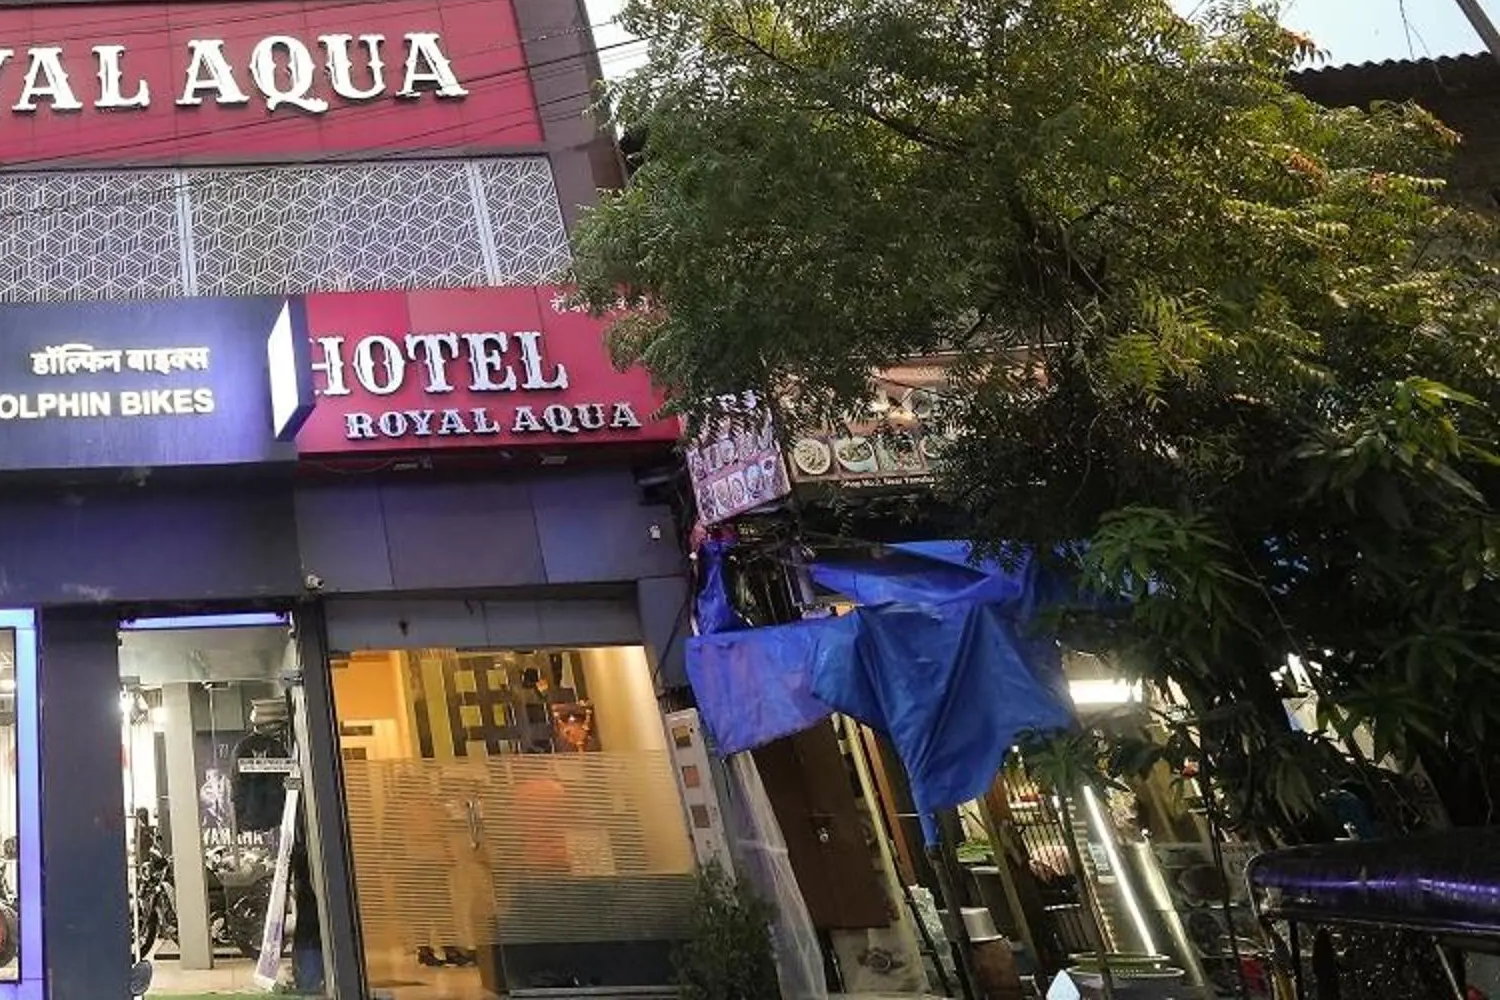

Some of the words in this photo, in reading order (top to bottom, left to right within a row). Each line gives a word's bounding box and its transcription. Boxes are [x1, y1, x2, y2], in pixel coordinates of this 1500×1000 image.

[176, 32, 468, 113] AQUA
[121, 389, 215, 415] BIKES
[344, 407, 500, 439] ROYAL
[512, 402, 642, 433] AQUA
